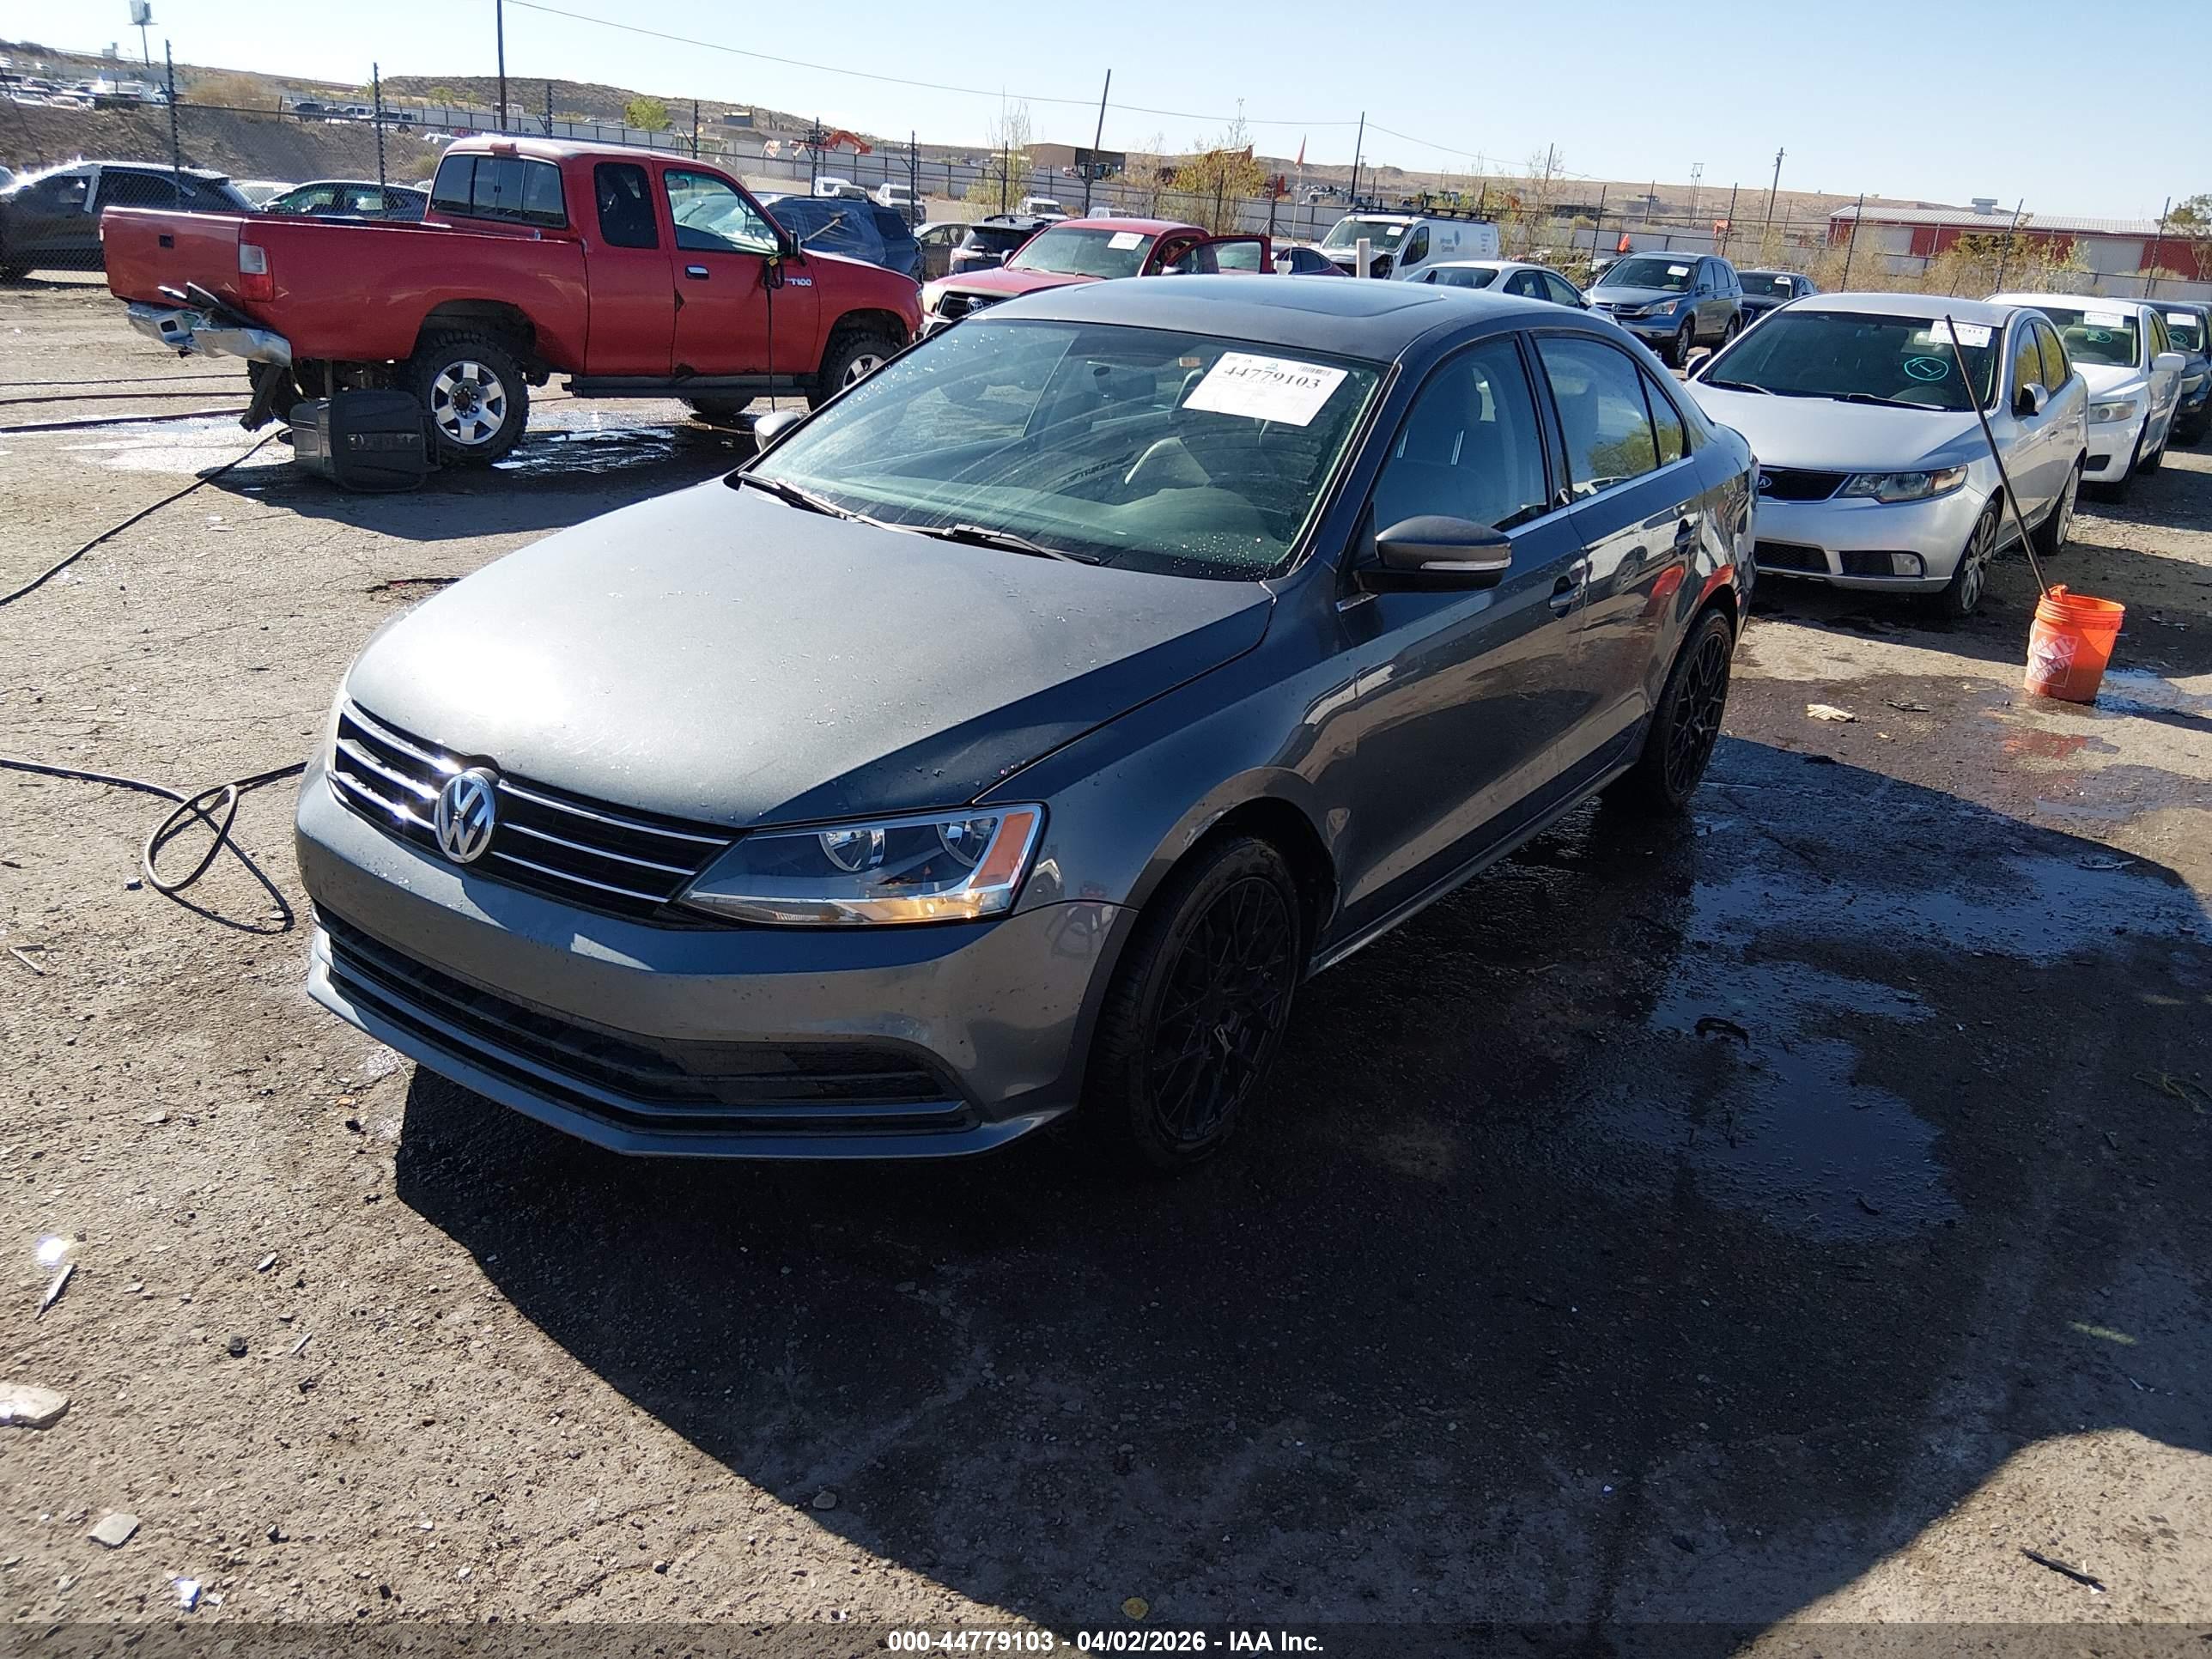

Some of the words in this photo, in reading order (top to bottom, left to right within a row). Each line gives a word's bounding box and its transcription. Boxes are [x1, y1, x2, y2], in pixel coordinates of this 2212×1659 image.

[790, 277, 812, 287] T100
[1224, 366, 1322, 389] 44779103
[2028, 636, 2076, 673] HOME
